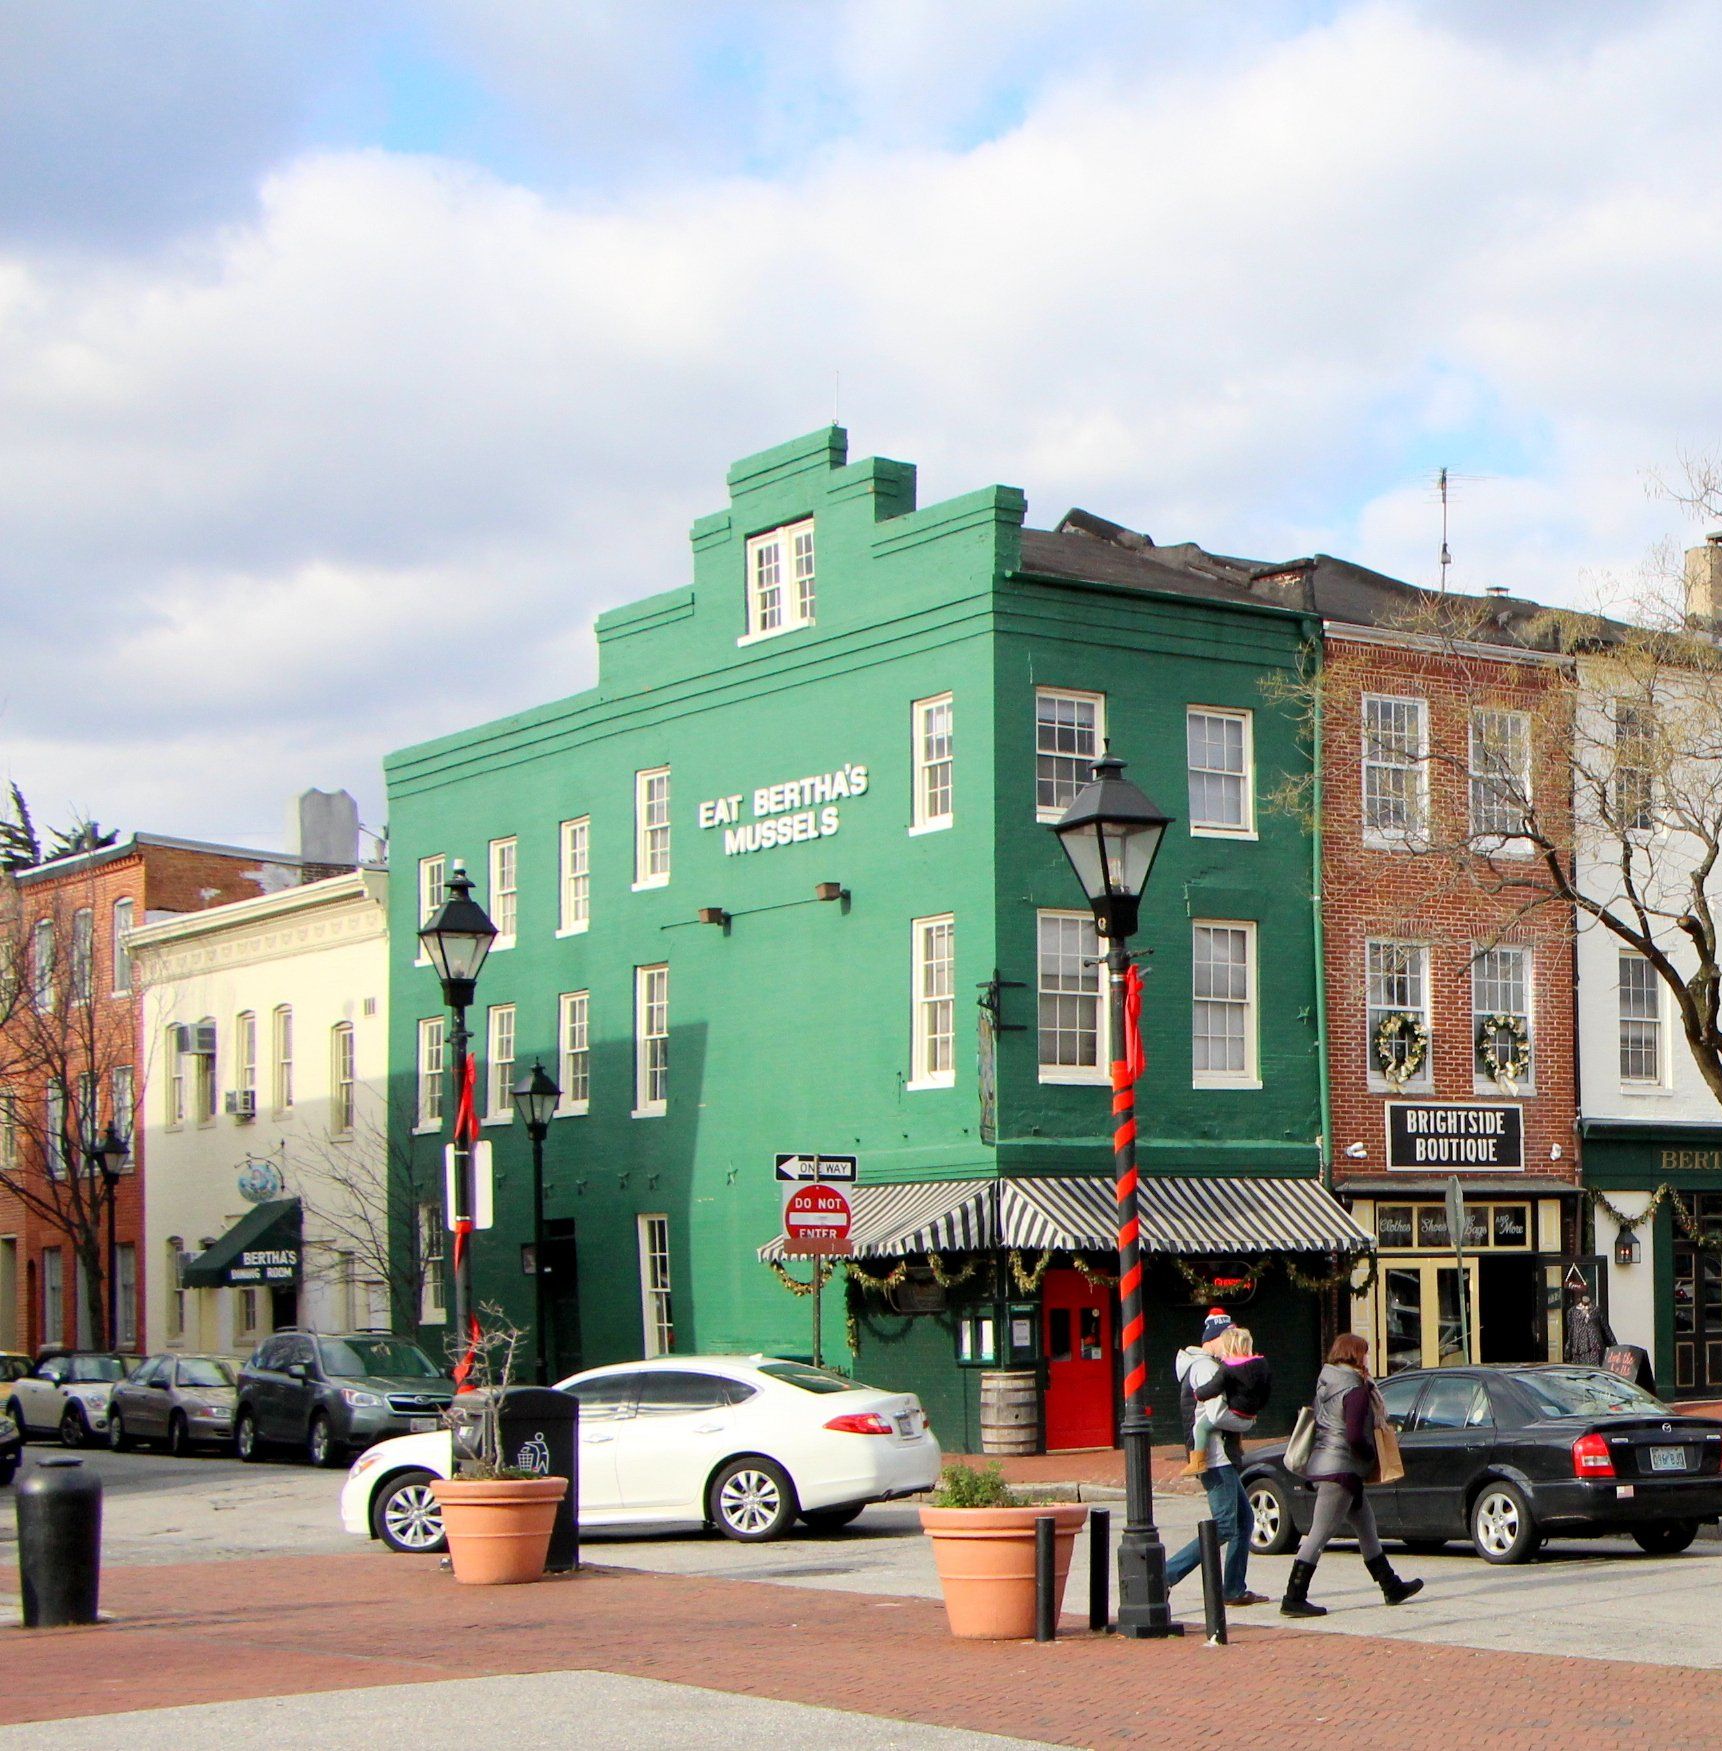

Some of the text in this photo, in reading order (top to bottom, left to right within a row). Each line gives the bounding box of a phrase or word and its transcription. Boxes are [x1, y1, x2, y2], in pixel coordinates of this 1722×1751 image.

[699, 763, 869, 829] EAT BERTHA'S
[724, 806, 840, 856] MUSSELS
[1407, 1109, 1505, 1135] BRIGHTSIDE
[1416, 1138, 1498, 1163] BOUTIQUE
[800, 1163, 848, 1174] ONE WAY
[795, 1197, 842, 1209] DO NOT
[1379, 1216, 1411, 1233] Clothes
[1421, 1218, 1448, 1233] Shoes
[1464, 1221, 1487, 1239] Bags
[1499, 1221, 1524, 1235] More
[800, 1228, 837, 1239] ENTER
[243, 1250, 298, 1266] BERTHA'S
[266, 1266, 292, 1279] ROOM
